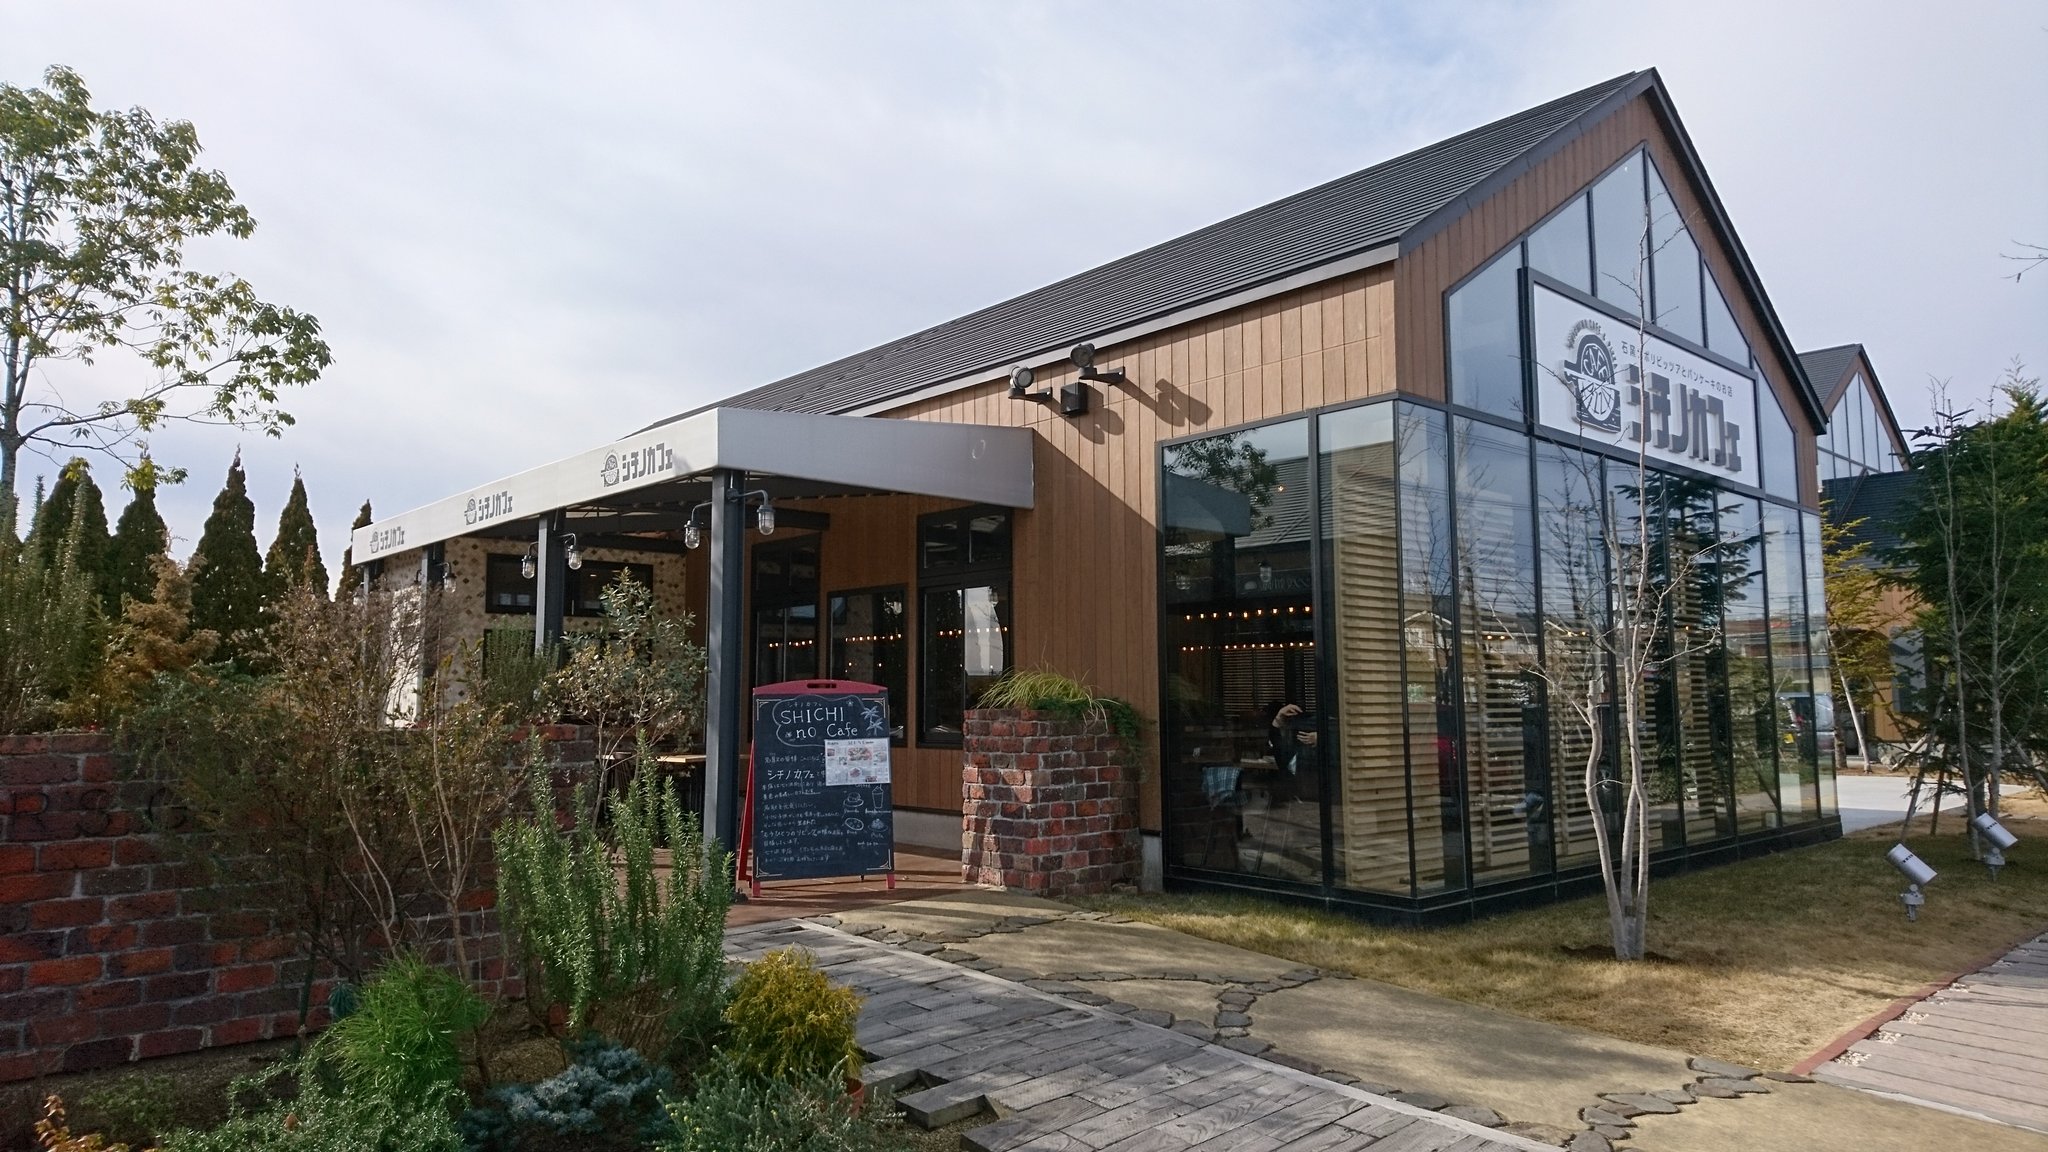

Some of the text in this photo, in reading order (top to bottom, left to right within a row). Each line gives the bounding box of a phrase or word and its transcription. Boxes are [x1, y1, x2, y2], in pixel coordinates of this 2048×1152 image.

[1583, 347, 1608, 381] CAFE
[1625, 363, 1742, 472] シチノカフェ
[622, 442, 673, 483] シチノカフェ
[478, 490, 513, 522] シチノカフェ
[380, 526, 405, 550] シチノカフェ
[780, 706, 844, 725] SHICHI
[796, 721, 858, 739] no Cafe
[767, 769, 815, 781] シチノカフェ
